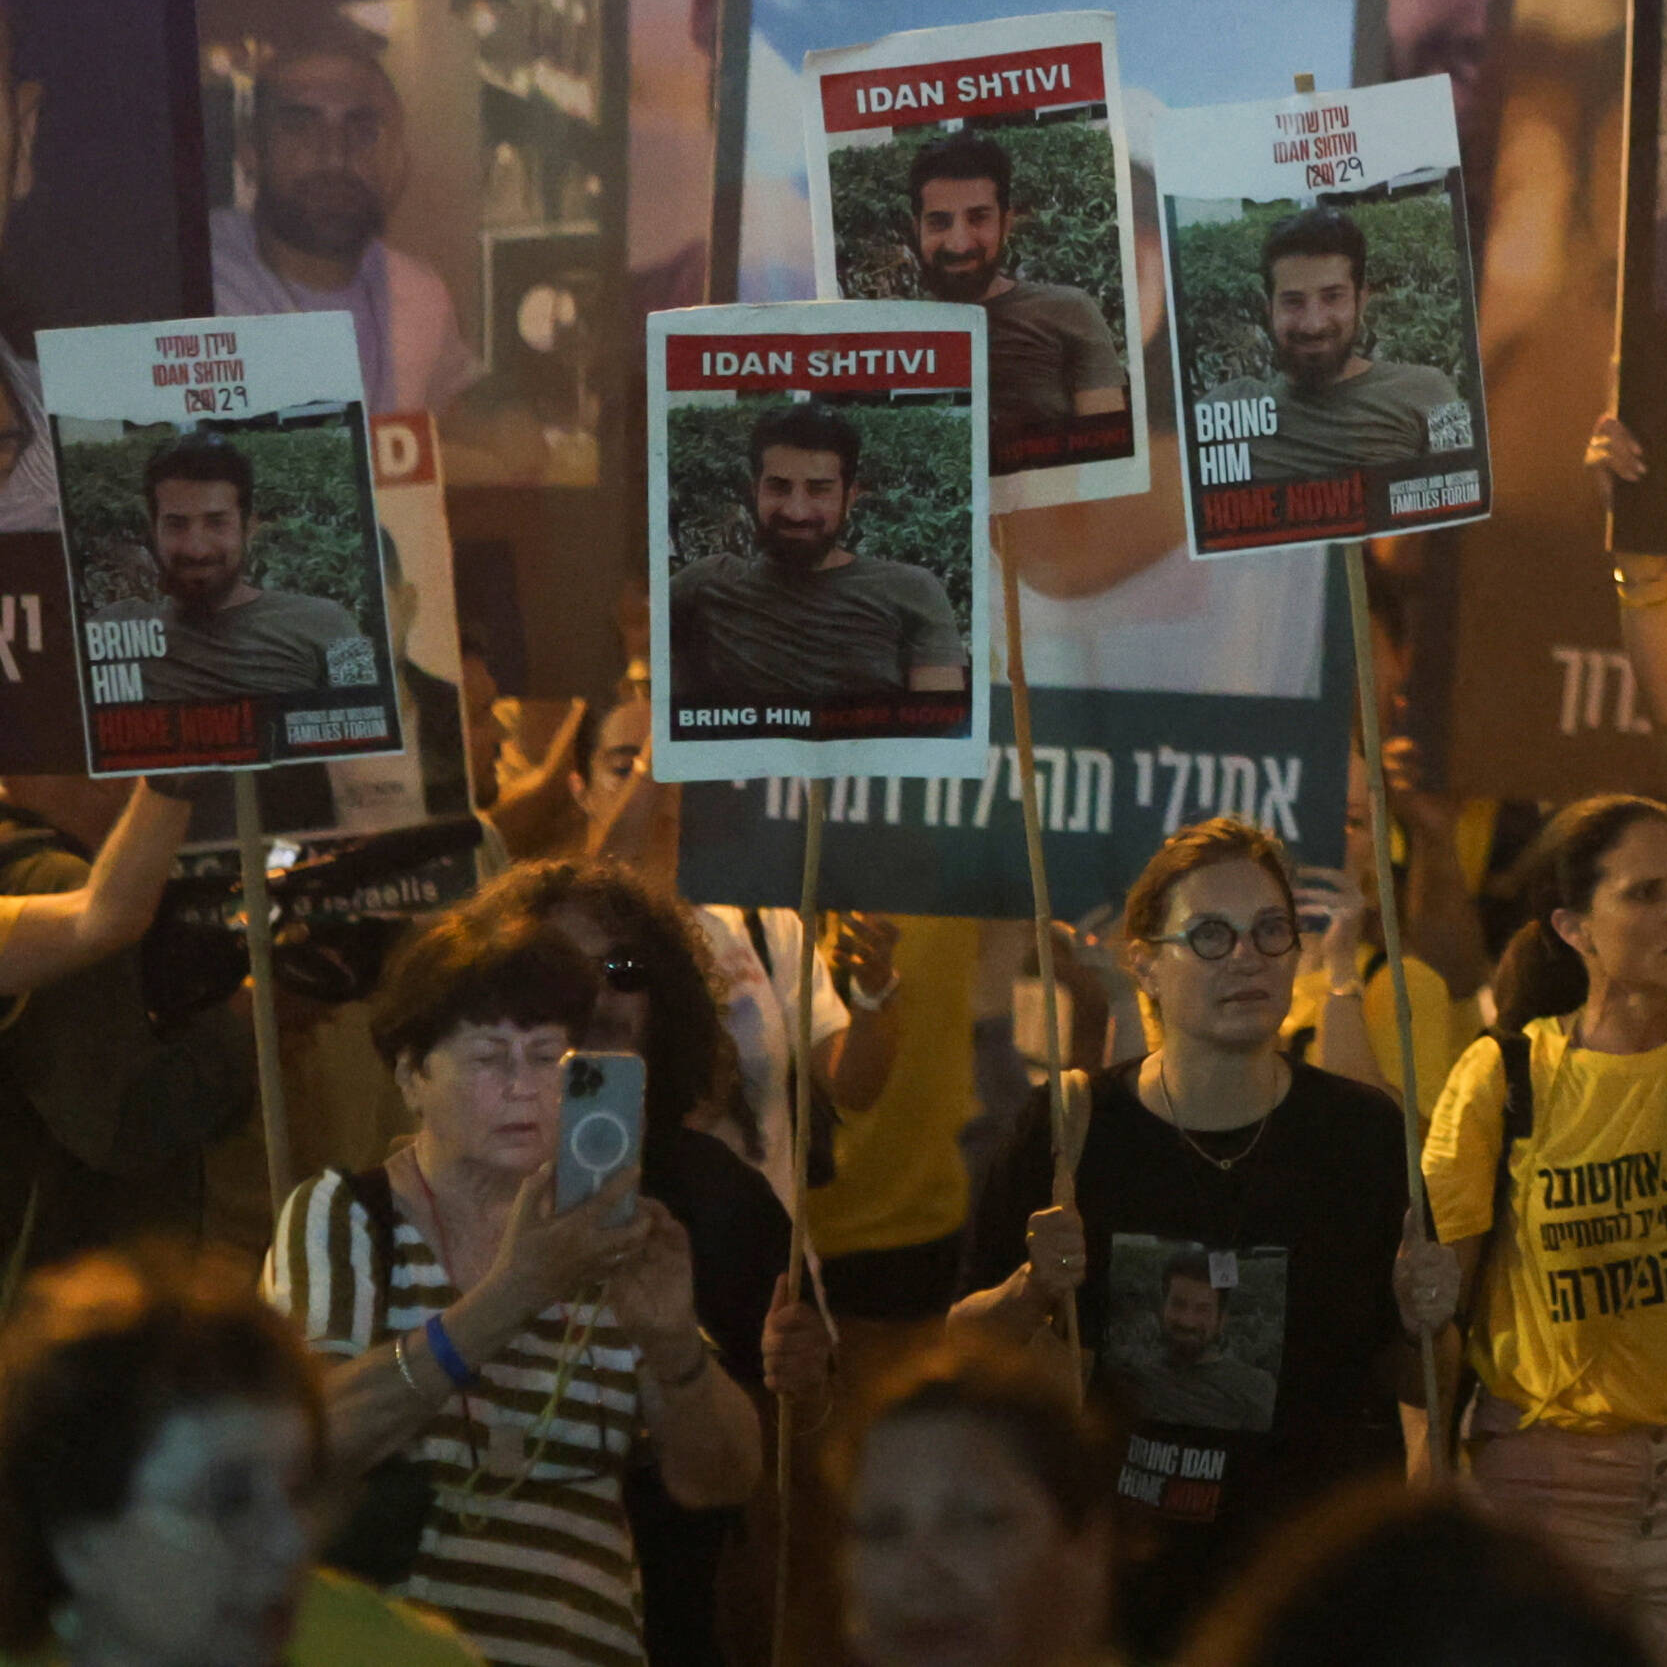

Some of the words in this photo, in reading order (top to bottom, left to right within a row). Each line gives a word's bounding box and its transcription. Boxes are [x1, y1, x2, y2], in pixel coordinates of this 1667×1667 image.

[856, 81, 944, 114] IDAN
[957, 64, 1071, 102] SHTIVI
[1322, 106, 1349, 133] עידן
[1273, 139, 1310, 164] IDAN
[1314, 131, 1357, 160] SHTIVI
[1336, 156, 1364, 182] 29
[152, 363, 189, 386] IDAN
[194, 359, 244, 384] SHTIVI
[702, 351, 793, 376] IDAN
[808, 348, 936, 377] SHTIVI
[218, 386, 248, 411] 29
[1195, 396, 1278, 443] BRING
[1199, 442, 1251, 485] HIM
[1203, 486, 1280, 531] HOME
[1286, 470, 1367, 521] NOW!
[1391, 490, 1440, 515] FAMILIES
[1441, 483, 1480, 507] FORUM
[86, 618, 167, 661] BRING
[91, 662, 144, 704] HIM
[679, 708, 757, 726] BRING
[766, 709, 811, 726] HIM
[1133, 745, 1302, 842] אמילי
[1180, 1447, 1226, 1481] IDAN
